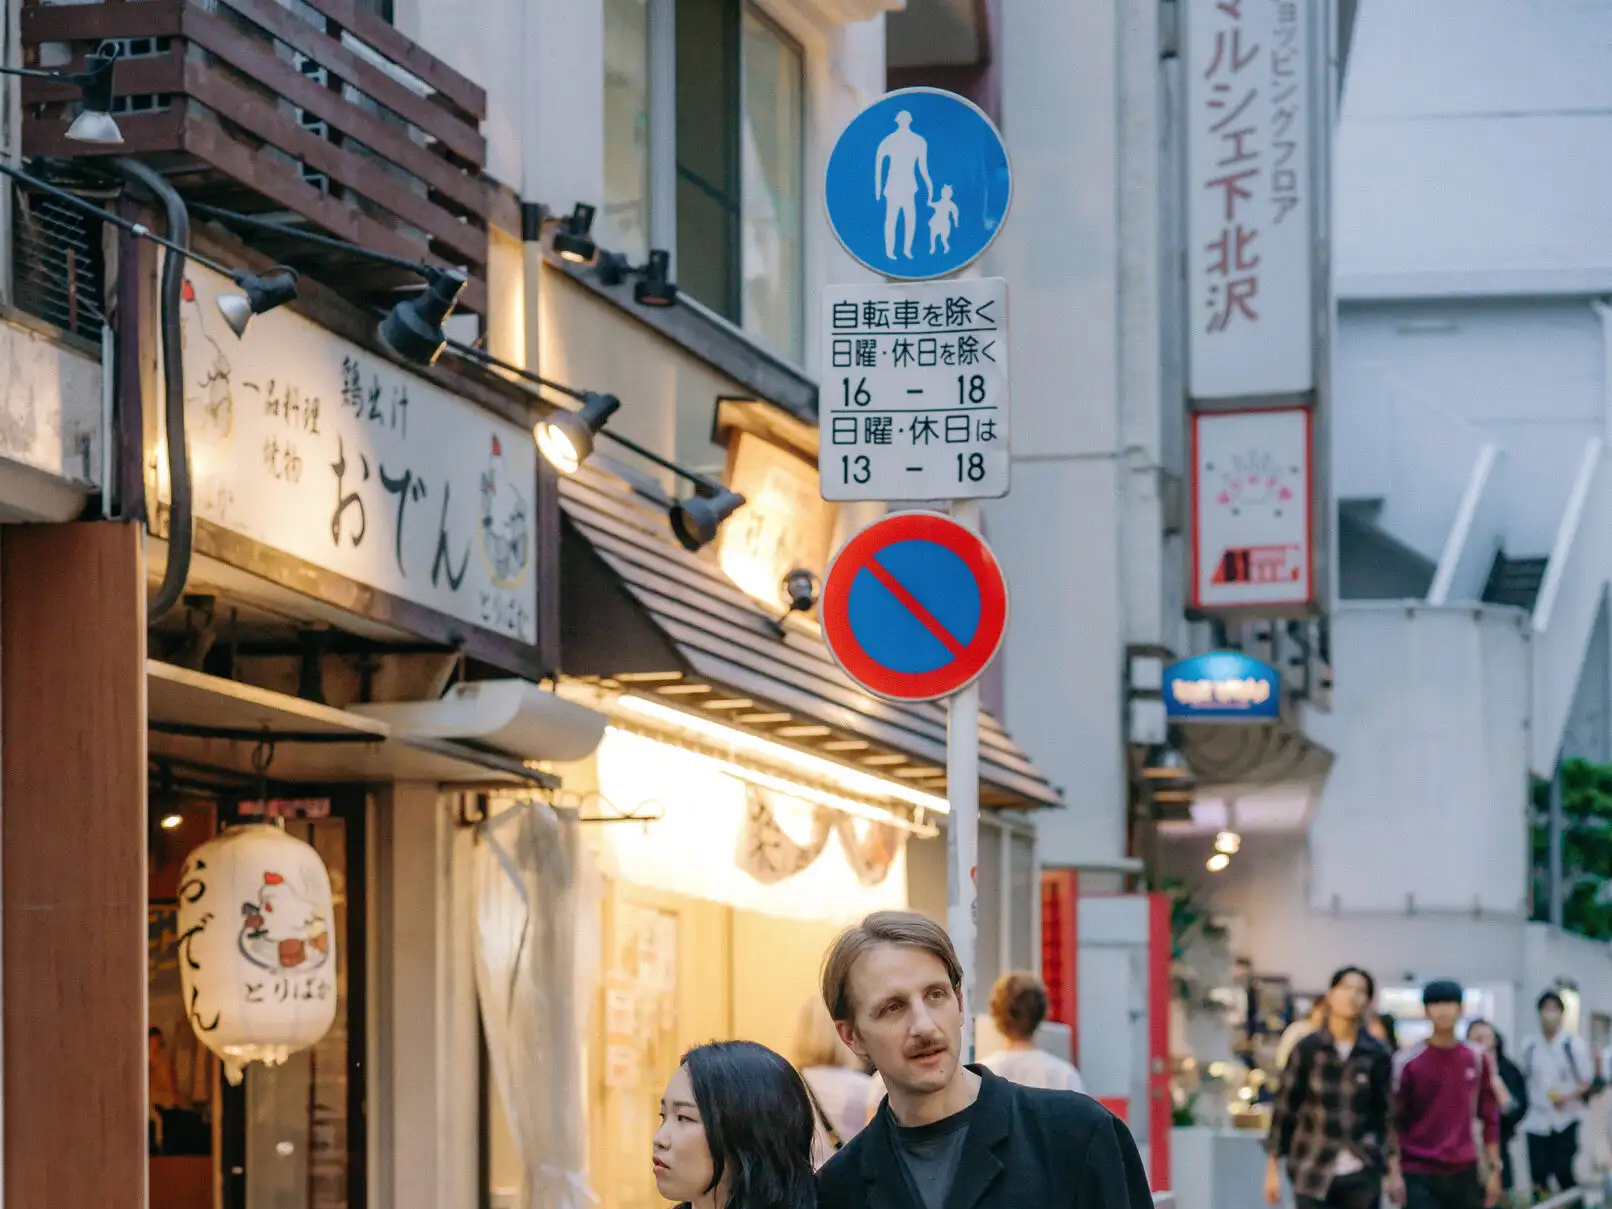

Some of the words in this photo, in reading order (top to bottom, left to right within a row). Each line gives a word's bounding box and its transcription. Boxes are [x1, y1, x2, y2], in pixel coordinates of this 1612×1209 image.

[832, 296, 996, 329] 自転車を除く
[832, 335, 996, 367] 日曜・休日を除く
[242, 379, 320, 434] 一品料理
[842, 377, 871, 407] 16
[957, 375, 986, 404] 18
[832, 414, 998, 445] 日曜・休日は
[841, 454, 871, 485] 13
[957, 452, 986, 482] 18
[330, 431, 470, 592] おでん
[176, 858, 220, 1031] おでん
